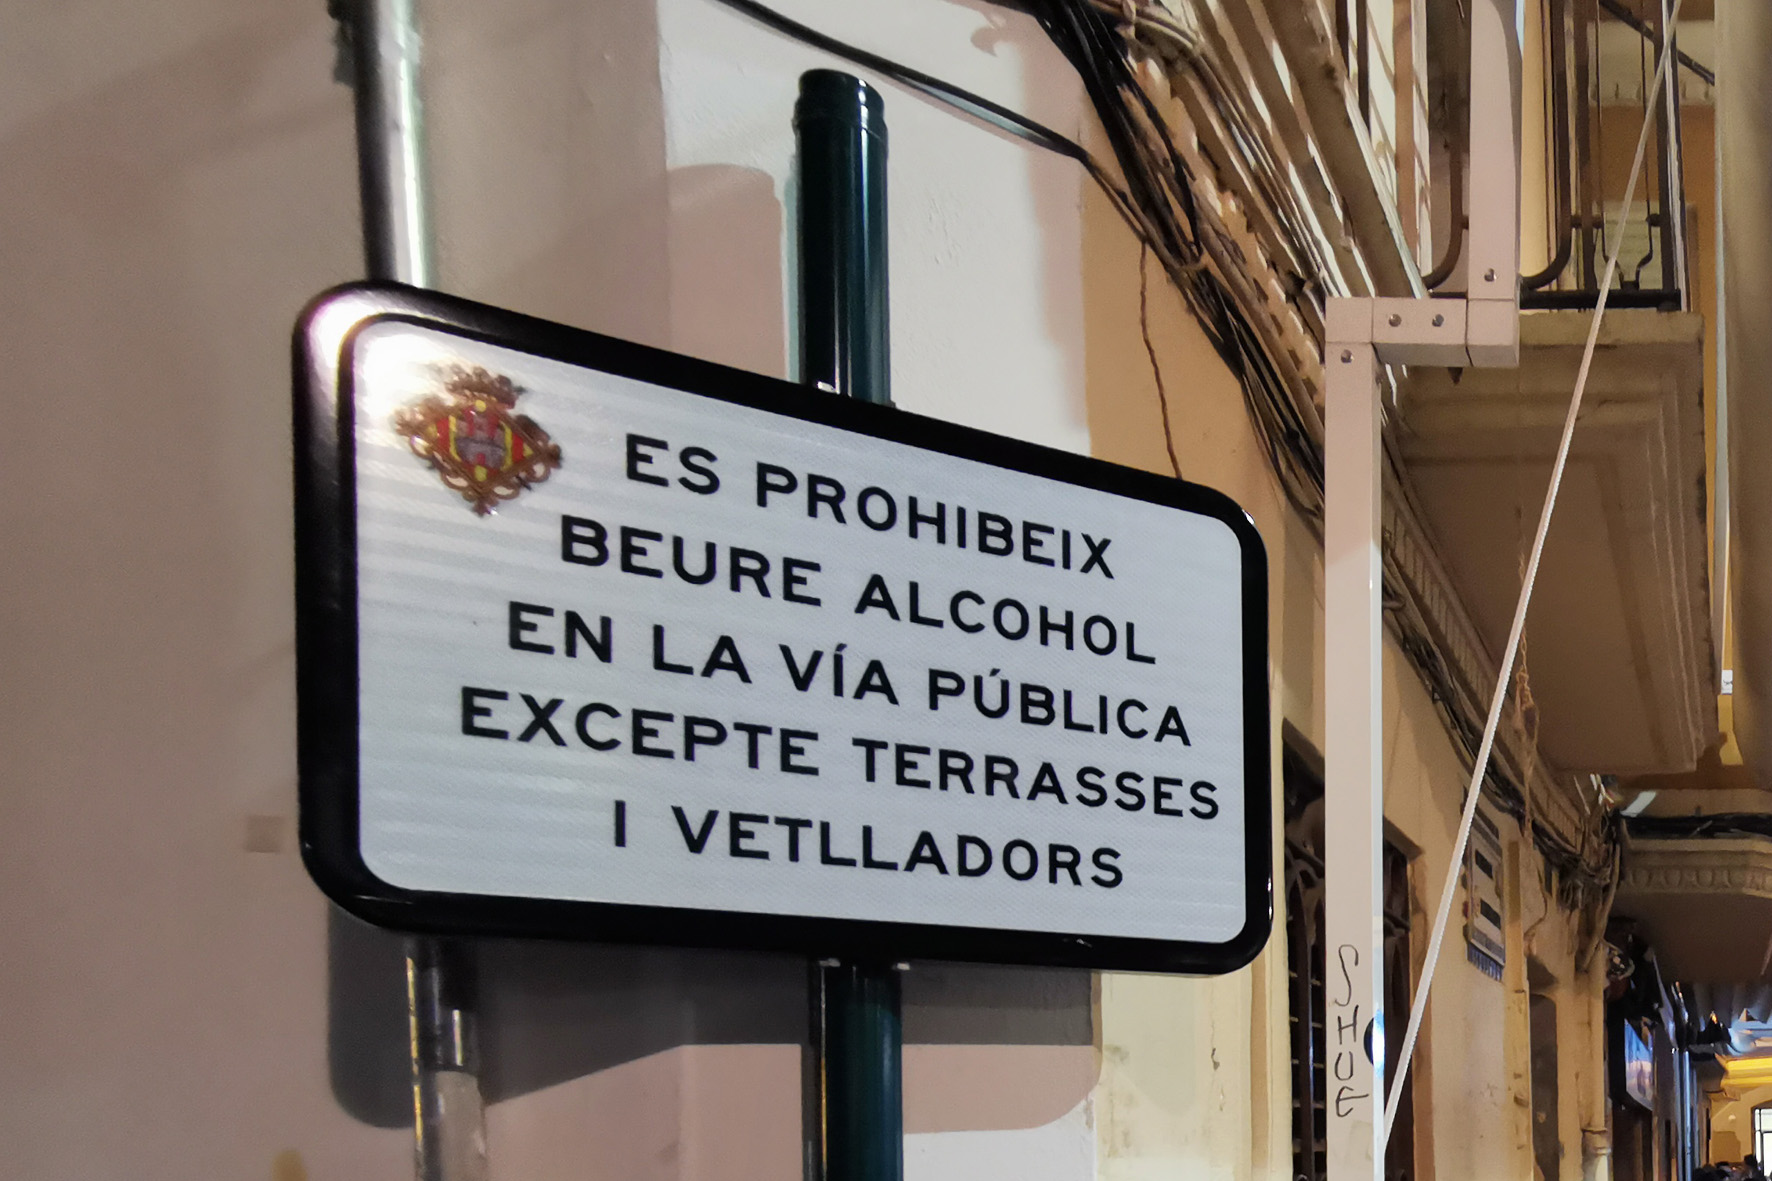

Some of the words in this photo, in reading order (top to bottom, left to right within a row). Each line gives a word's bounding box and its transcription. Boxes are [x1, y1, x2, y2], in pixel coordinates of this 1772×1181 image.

[625, 433, 721, 496] ES
[756, 461, 1115, 580] PROHIBEIX
[560, 514, 822, 607] BEURE
[854, 573, 1156, 665] ALCOHOL
[508, 600, 613, 664] EN
[652, 623, 753, 685] LA
[778, 642, 900, 706] VÍA
[928, 667, 1192, 747] PÚBLICA
[460, 685, 820, 777] EXCEPTE
[851, 737, 1219, 821] TERRASSES
[613, 799, 627, 848] I
[670, 805, 1123, 889] VETLLADORS
